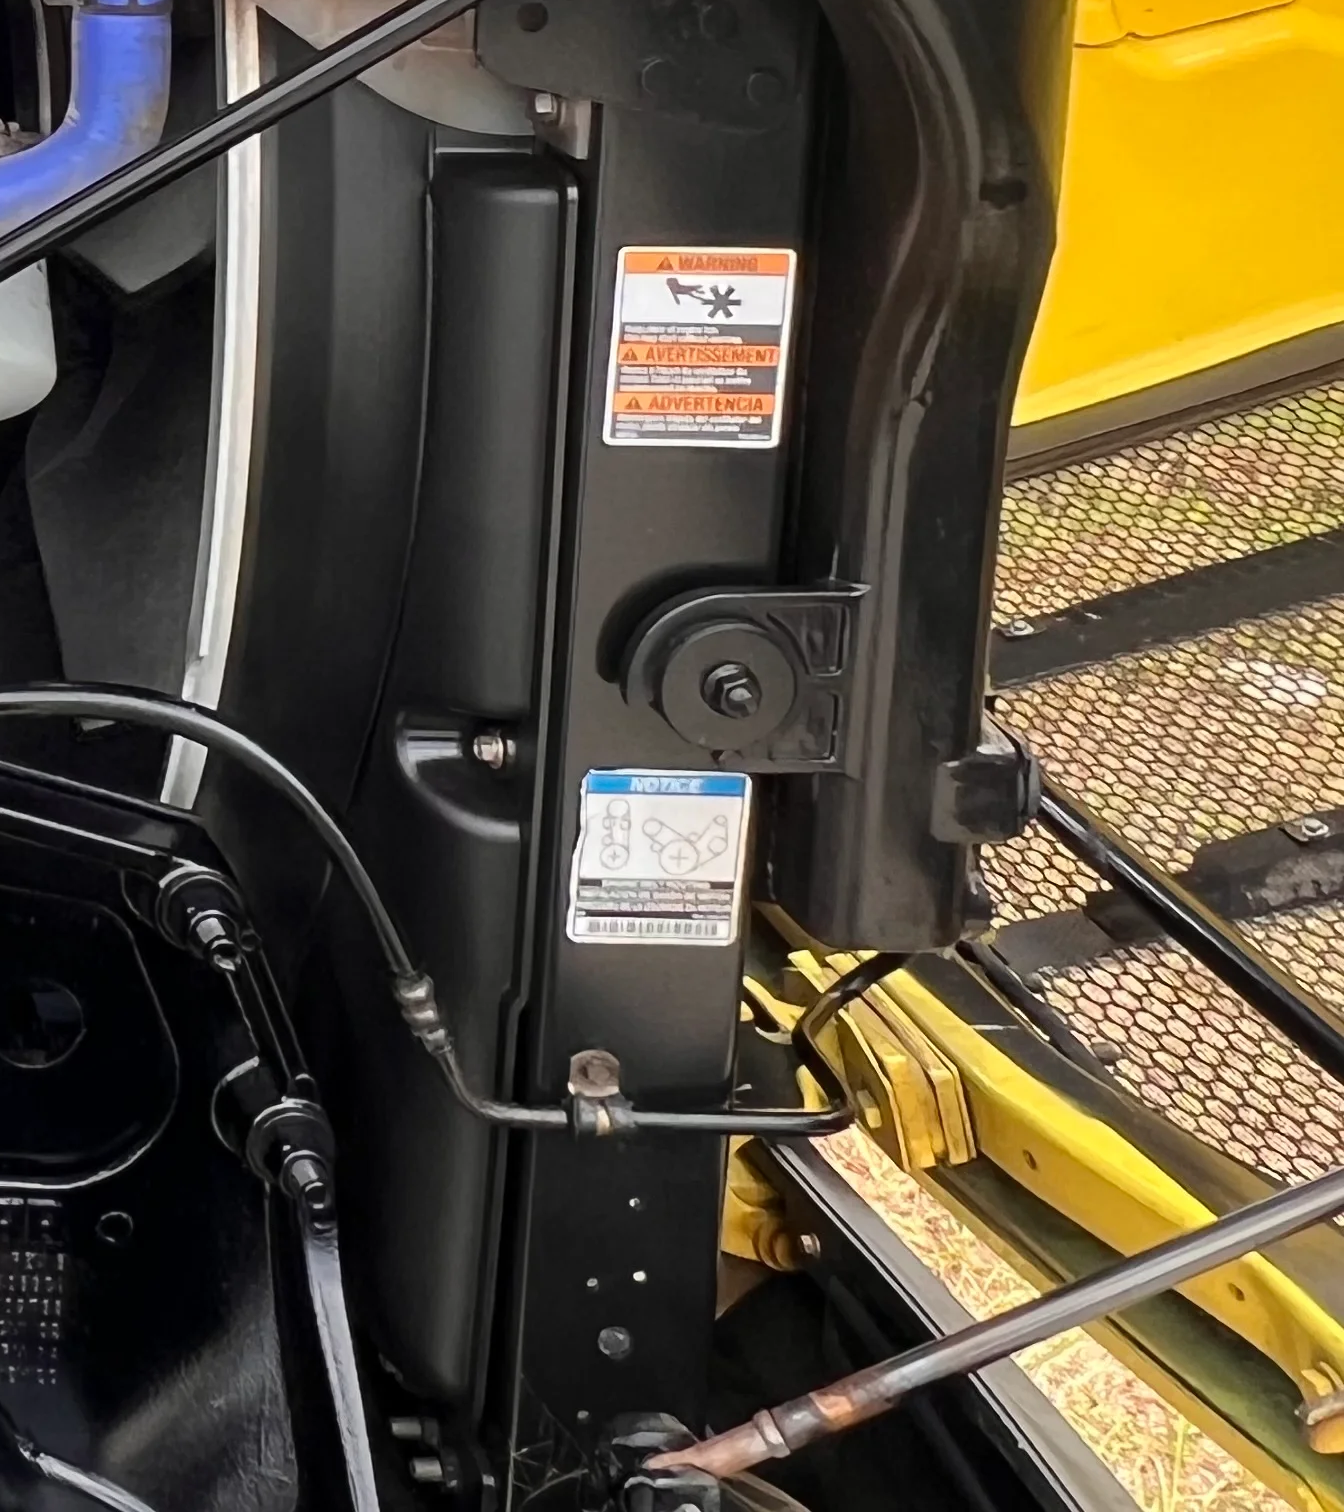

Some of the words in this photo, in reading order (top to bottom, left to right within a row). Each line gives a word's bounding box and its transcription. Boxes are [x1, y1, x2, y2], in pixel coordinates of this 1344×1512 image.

[678, 256, 758, 271] WARNING
[645, 347, 777, 364] AVERTISSEMENT
[648, 396, 763, 413] ADVERTENCIA
